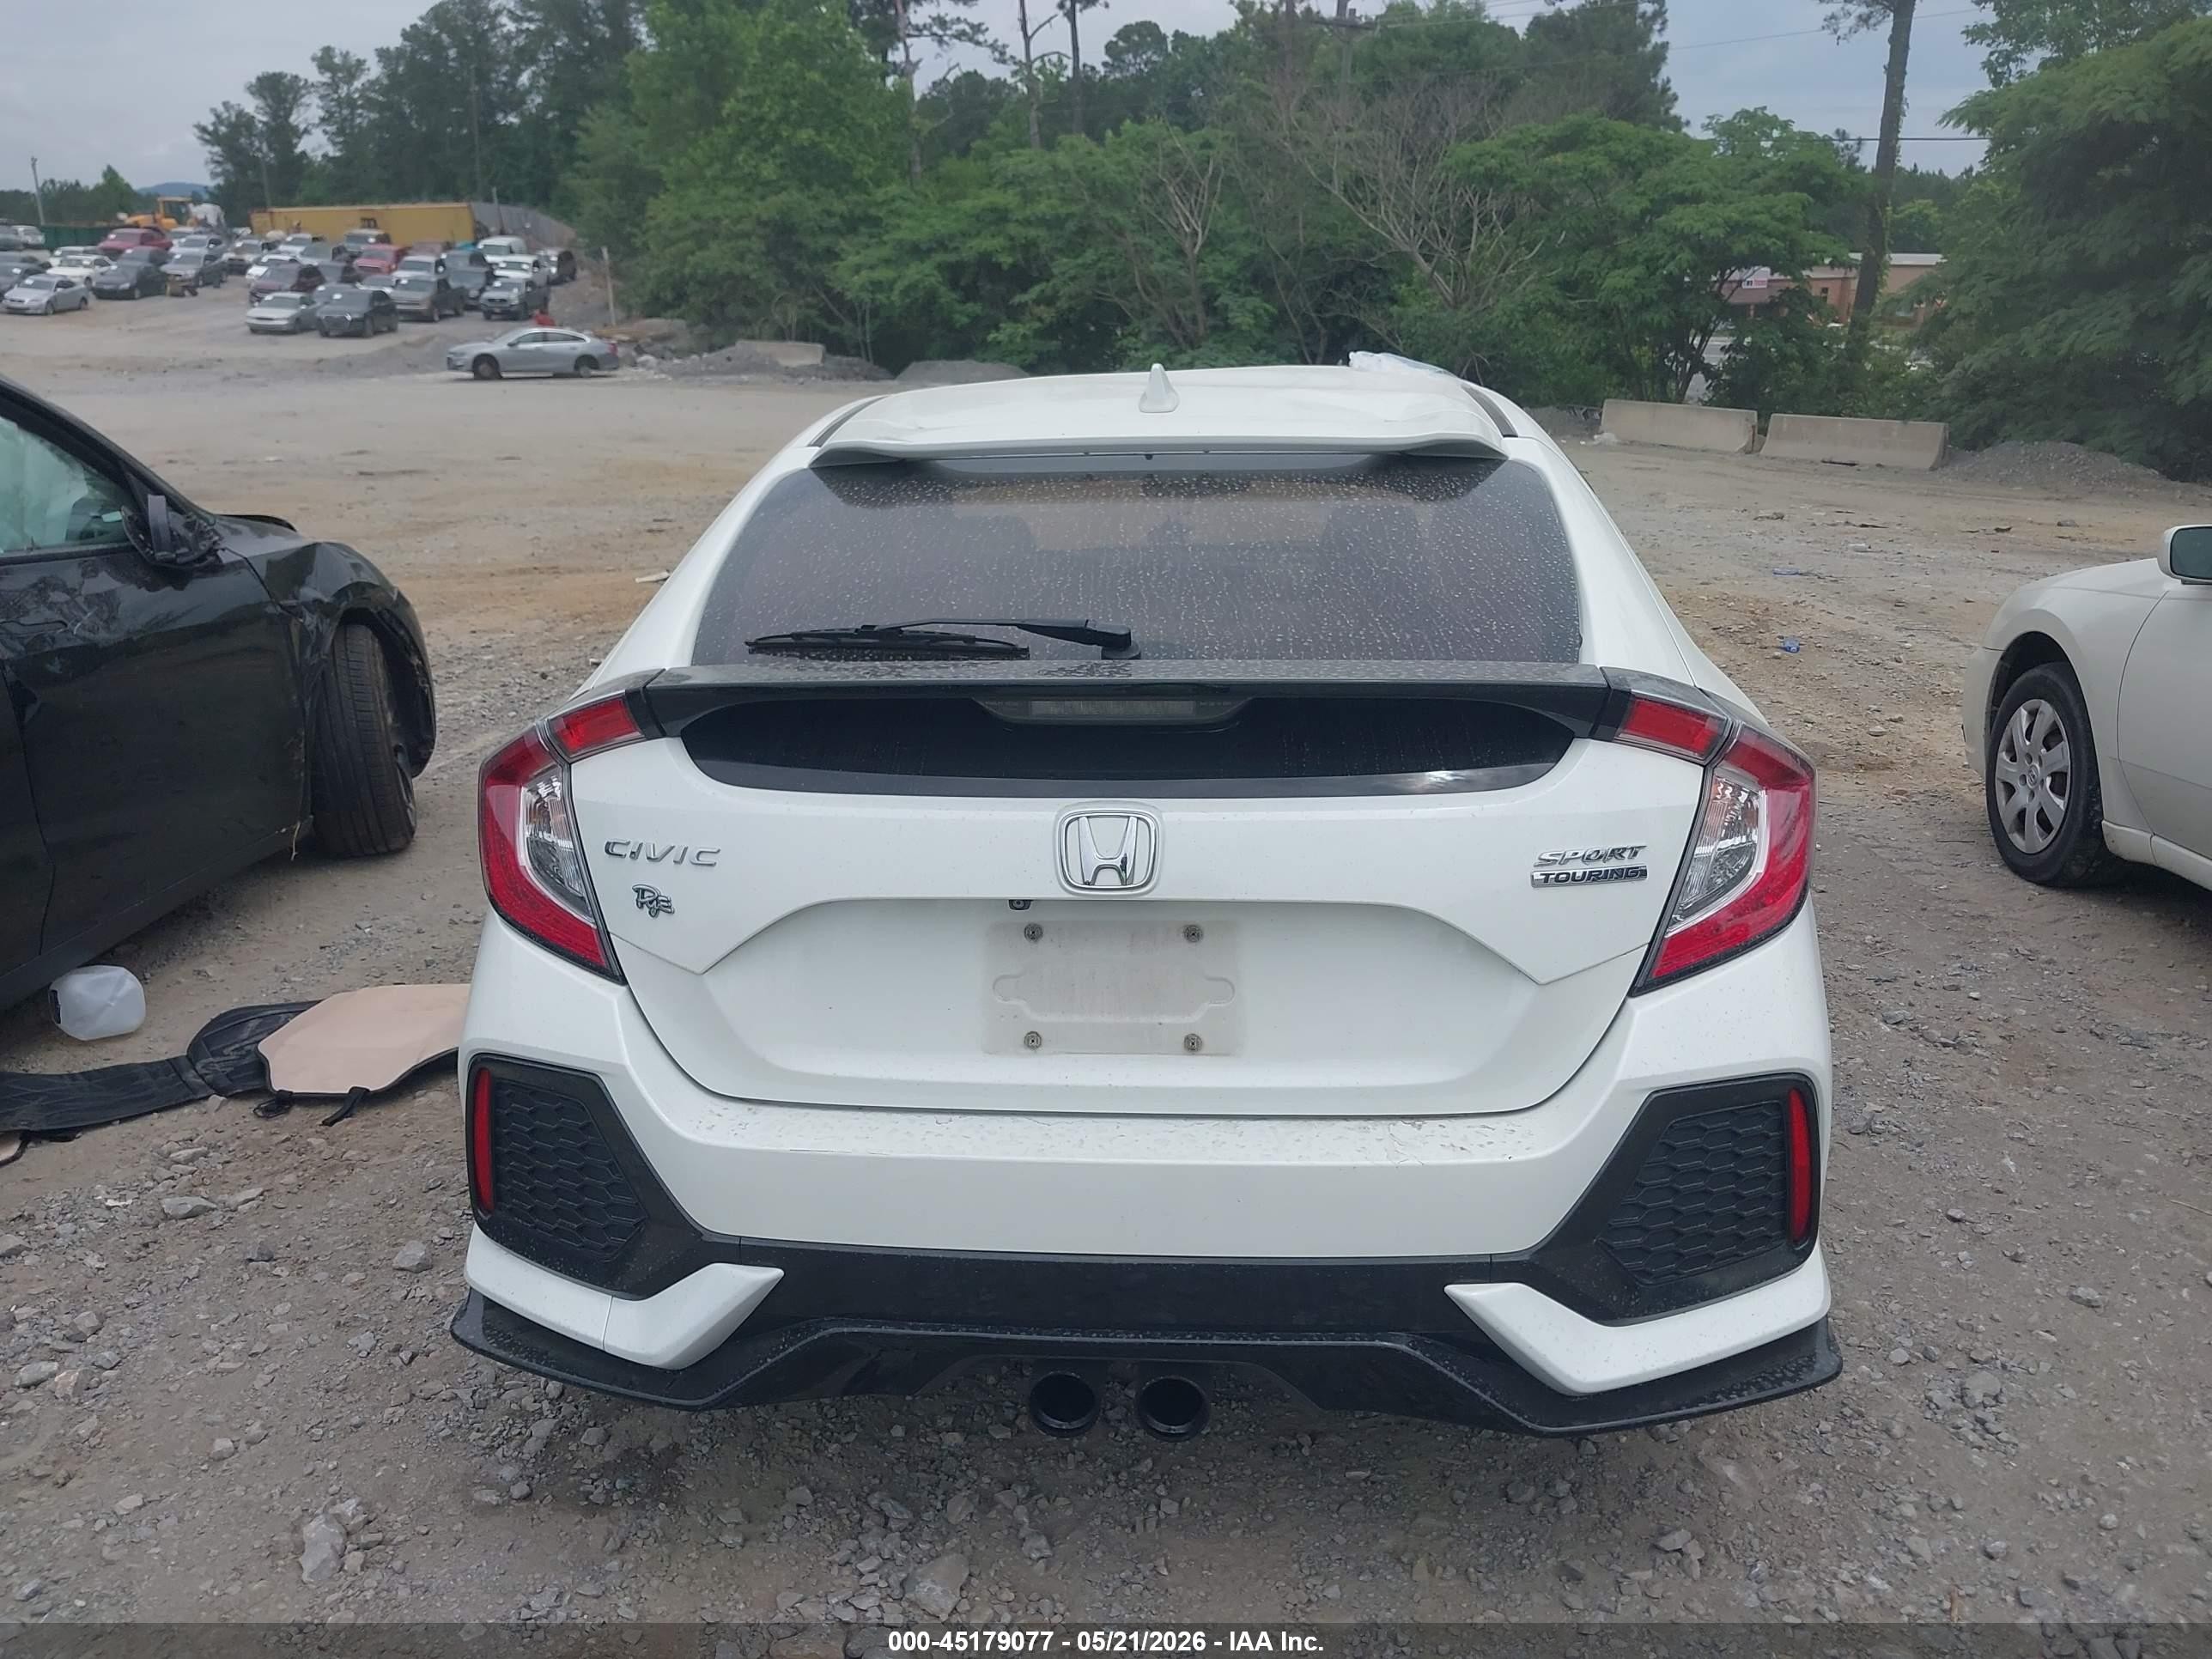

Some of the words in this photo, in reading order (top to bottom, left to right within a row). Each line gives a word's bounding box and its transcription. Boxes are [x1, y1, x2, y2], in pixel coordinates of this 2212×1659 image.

[605, 840, 721, 866] CIVIC
[1534, 846, 1647, 867] SPORT
[1538, 866, 1642, 884] TOURING
